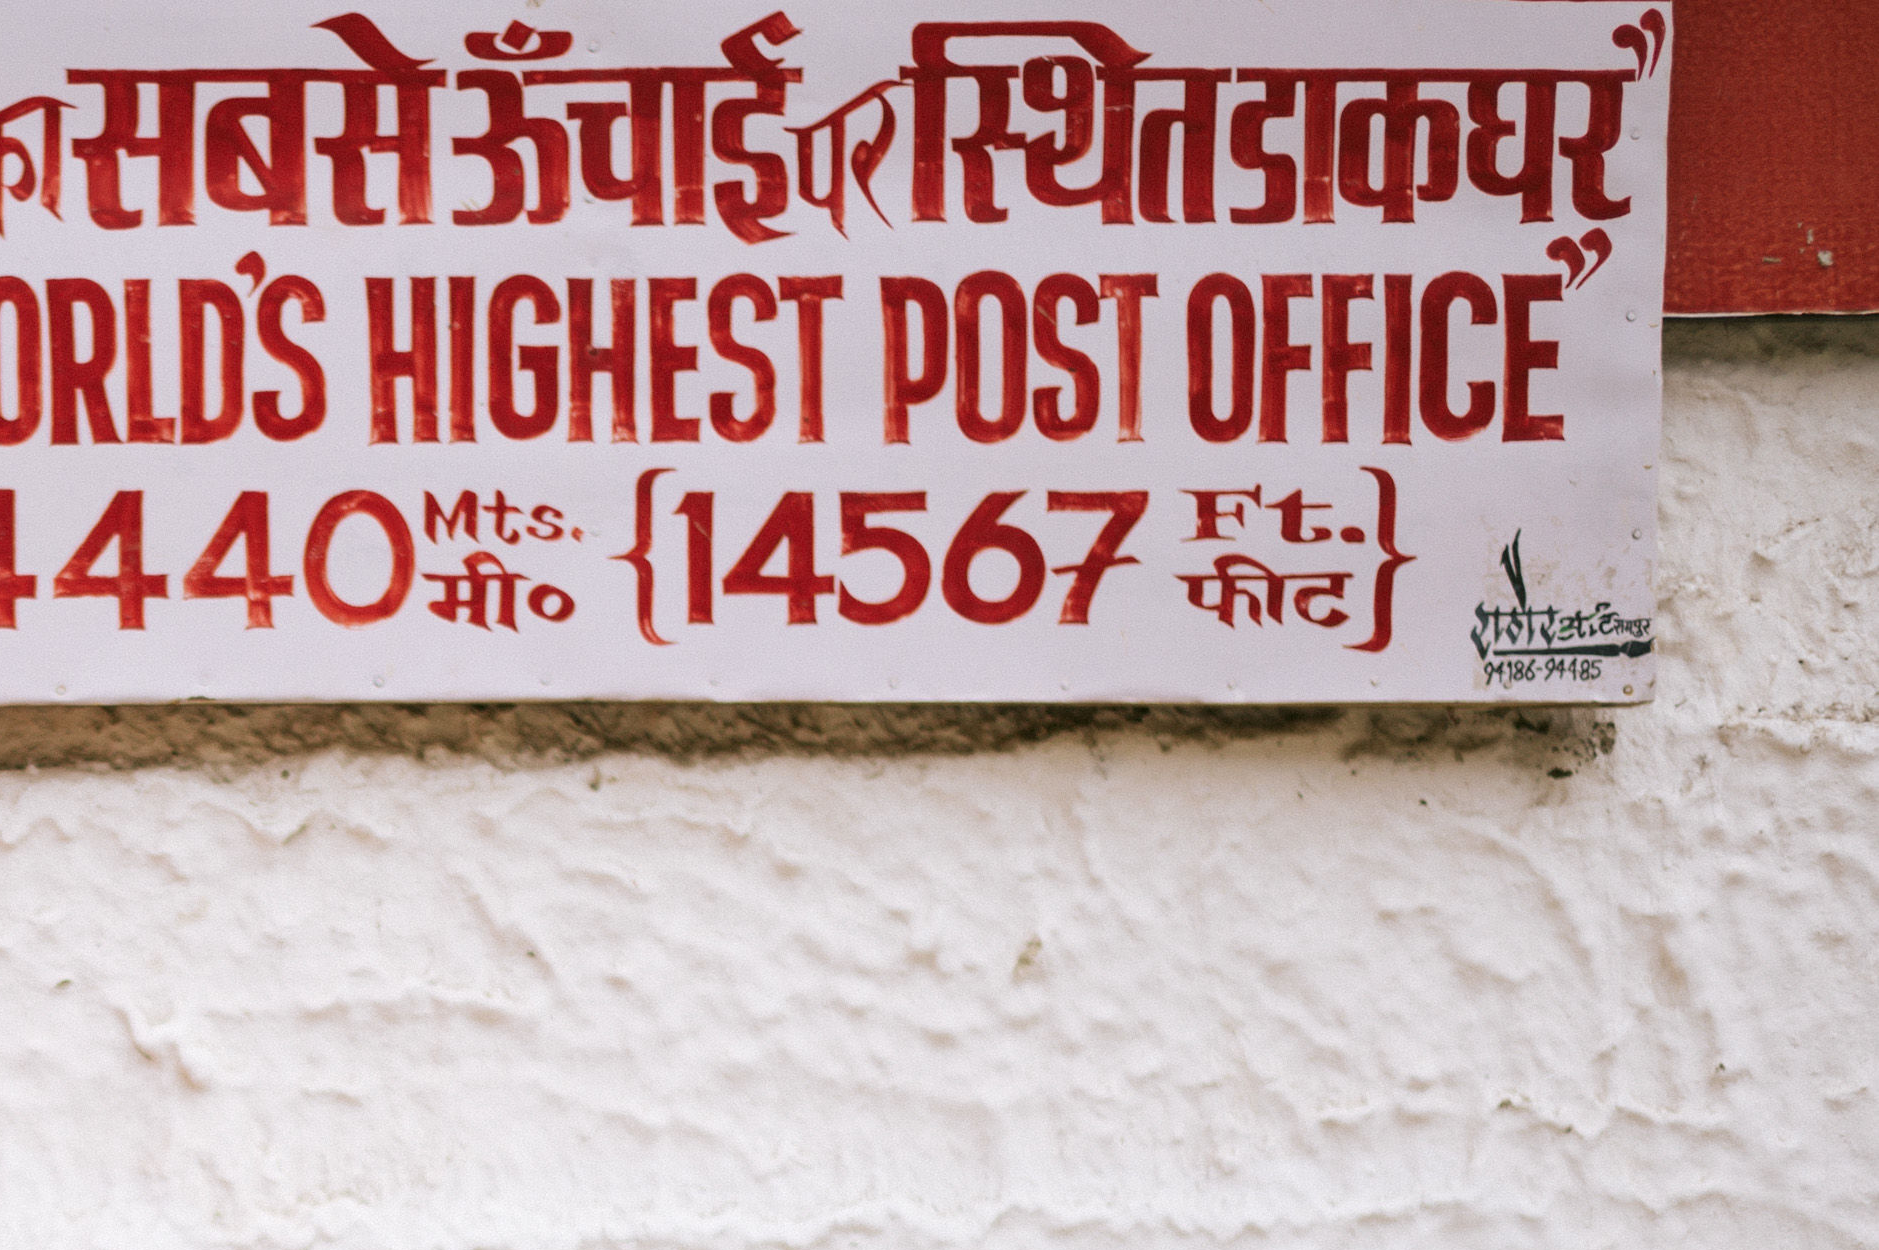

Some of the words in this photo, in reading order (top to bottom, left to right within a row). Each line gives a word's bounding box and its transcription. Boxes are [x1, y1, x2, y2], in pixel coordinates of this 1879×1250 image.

[783, 79, 914, 239] पर
[898, 20, 1231, 226] स्थित
[363, 272, 844, 445] HIGHEST
[878, 269, 1160, 445] POST
[422, 489, 583, 545] Mts.
[1174, 553, 1355, 630] फीट
